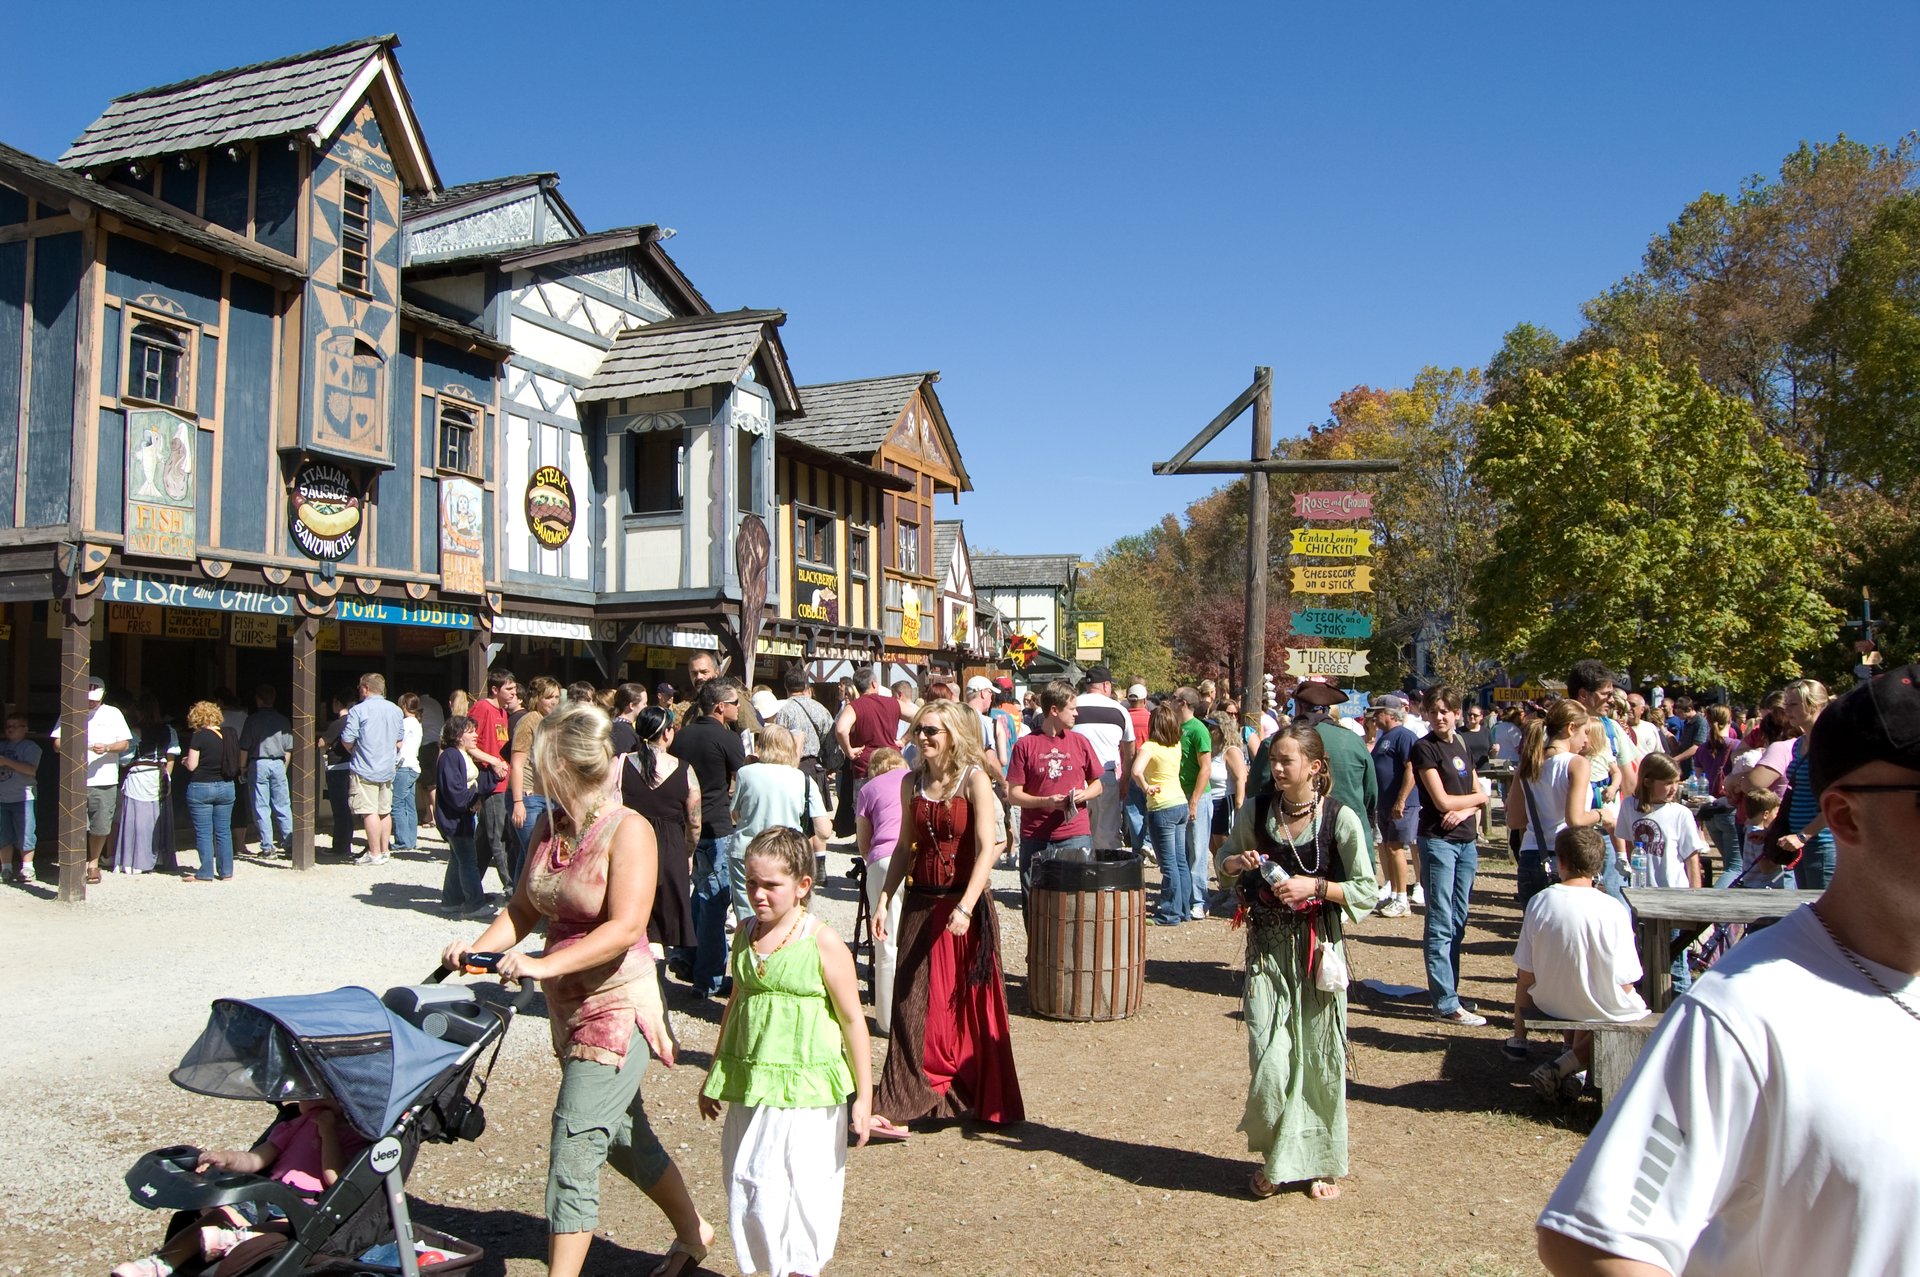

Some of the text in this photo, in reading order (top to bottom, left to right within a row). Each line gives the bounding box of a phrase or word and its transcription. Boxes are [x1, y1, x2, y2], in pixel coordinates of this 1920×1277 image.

[302, 465, 351, 490] ITALIAN
[536, 468, 568, 495] STEAK
[299, 482, 350, 503] SAUSAGE
[1301, 494, 1368, 514] Rose and Crown
[137, 504, 183, 533] FISH
[129, 533, 157, 553] AND
[1330, 532, 1358, 546] Loving
[1305, 544, 1353, 555] CHICKEN
[798, 568, 838, 592] BLACKBERRY
[1303, 569, 1356, 579] CHEESECAKE
[1305, 579, 1355, 589] on a STICK
[112, 569, 290, 615] FISH and CHIPS
[111, 604, 144, 620] CURLY
[341, 595, 470, 626] FOWL TIDBITS
[797, 603, 829, 623] COBBLER
[1305, 611, 1344, 624] STEAK
[127, 620, 152, 633] FRIES
[168, 615, 211, 628] CHICKEN
[234, 616, 254, 630] FISH
[494, 610, 546, 635] STEAK
[234, 630, 264, 644] CHIPS
[685, 628, 717, 648] LEGS
[1297, 650, 1357, 664] TURKEY
[1308, 664, 1349, 674] LEGGES
[1498, 688, 1530, 700] LEMON
[372, 1148, 399, 1162] Jeep
